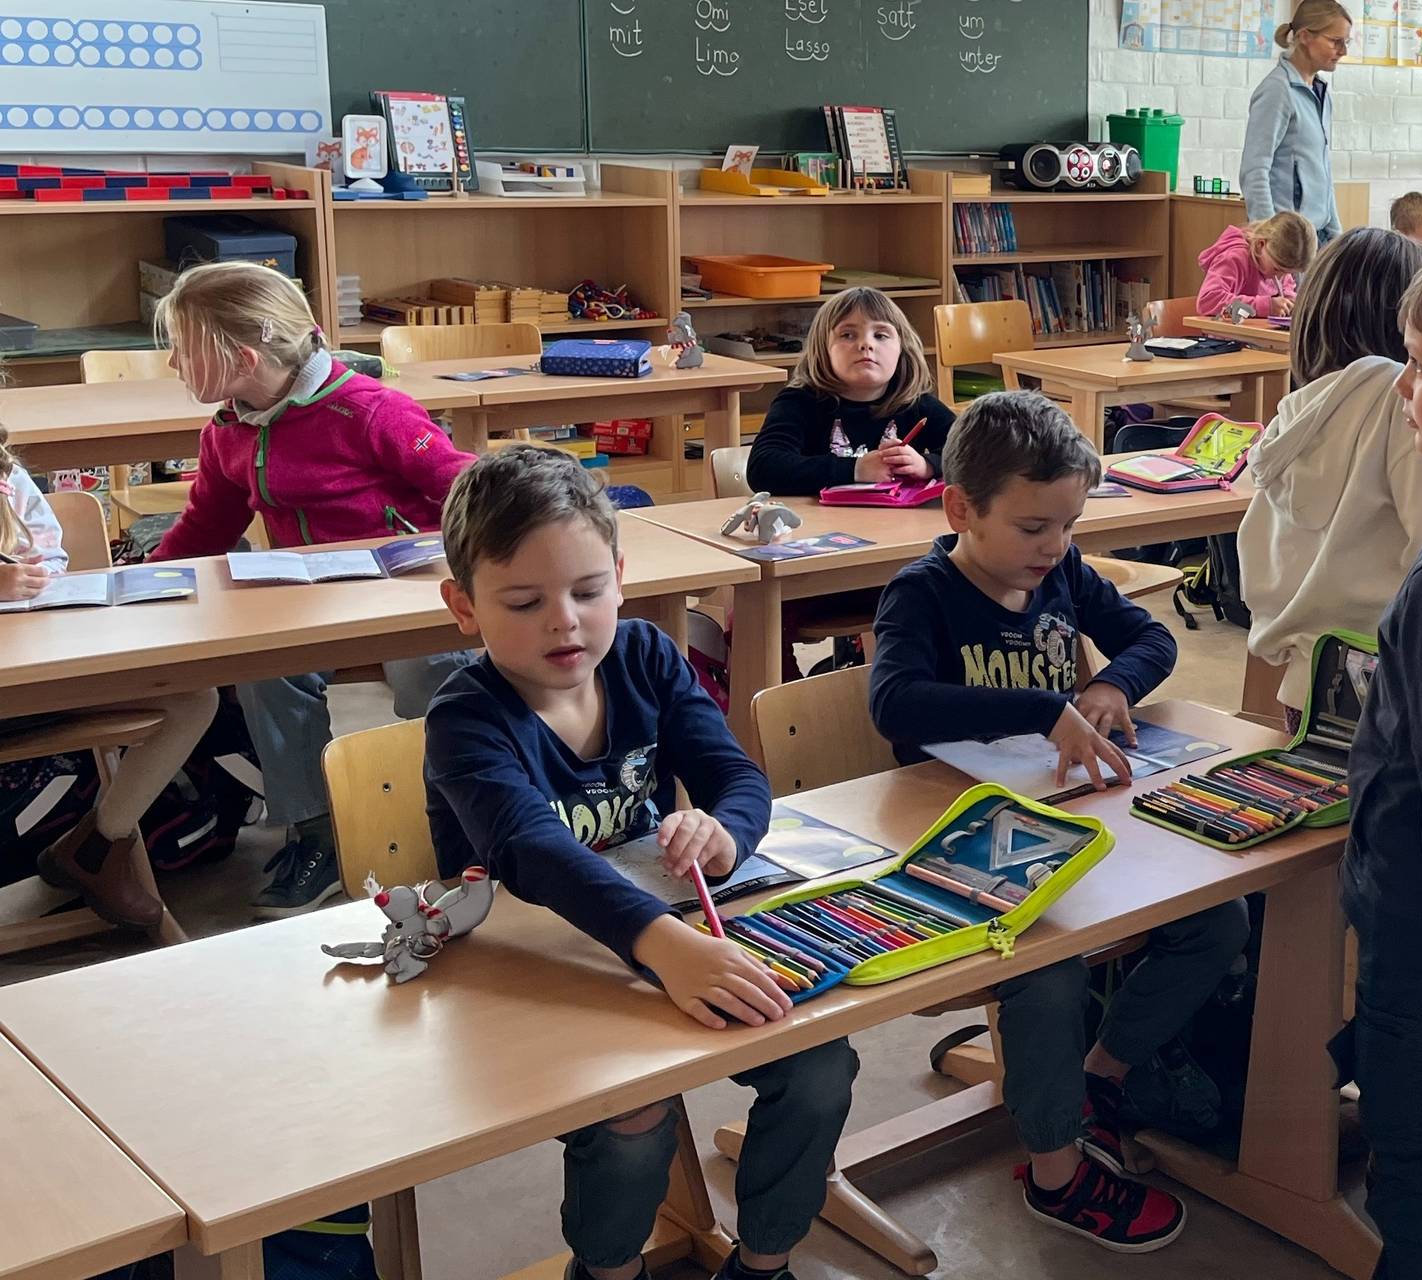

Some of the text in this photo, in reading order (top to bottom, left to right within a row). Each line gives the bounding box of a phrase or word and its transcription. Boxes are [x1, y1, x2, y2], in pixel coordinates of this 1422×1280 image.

[697, 0, 730, 21] Omi
[959, 14, 985, 29] um
[609, 19, 643, 45] mit
[785, 27, 830, 54] Lasso
[695, 36, 740, 64] Limo
[959, 46, 1002, 66] unter
